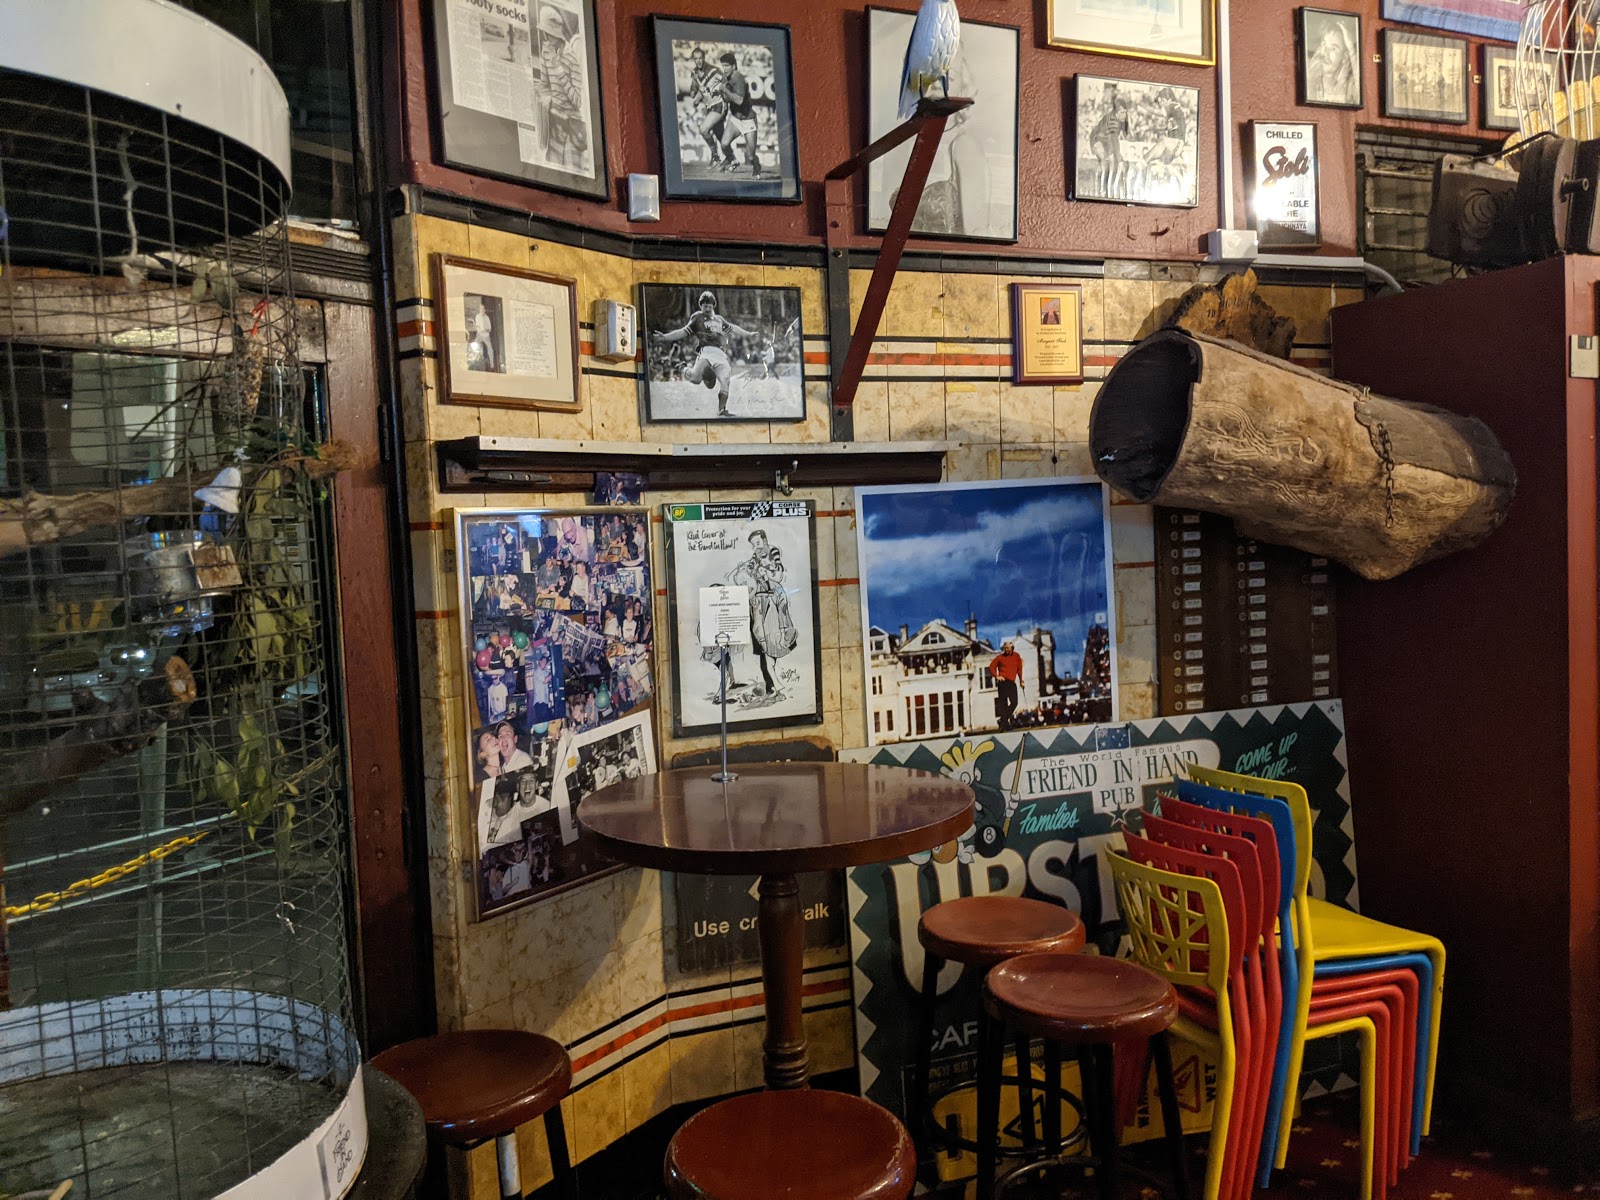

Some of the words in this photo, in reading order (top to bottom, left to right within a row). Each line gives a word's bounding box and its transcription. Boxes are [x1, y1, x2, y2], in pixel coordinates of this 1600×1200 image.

[466, 0, 494, 13] ooty
[496, 4, 527, 23] socks
[1266, 130, 1303, 140] CHILLED
[772, 508, 807, 517] PLUS
[1041, 757, 1065, 767] The
[1079, 750, 1122, 763] World
[1135, 744, 1181, 757] Famous
[1235, 742, 1274, 774] COME
[1279, 732, 1298, 757] UP
[1026, 763, 1098, 794] FRIEND
[1114, 757, 1134, 784] IN
[1145, 750, 1199, 780] HAND
[1100, 786, 1136, 808] PUB
[1019, 801, 1079, 835] Families
[985, 828, 993, 842] 8
[694, 920, 730, 938] Use
[1204, 1063, 1218, 1103] WET
